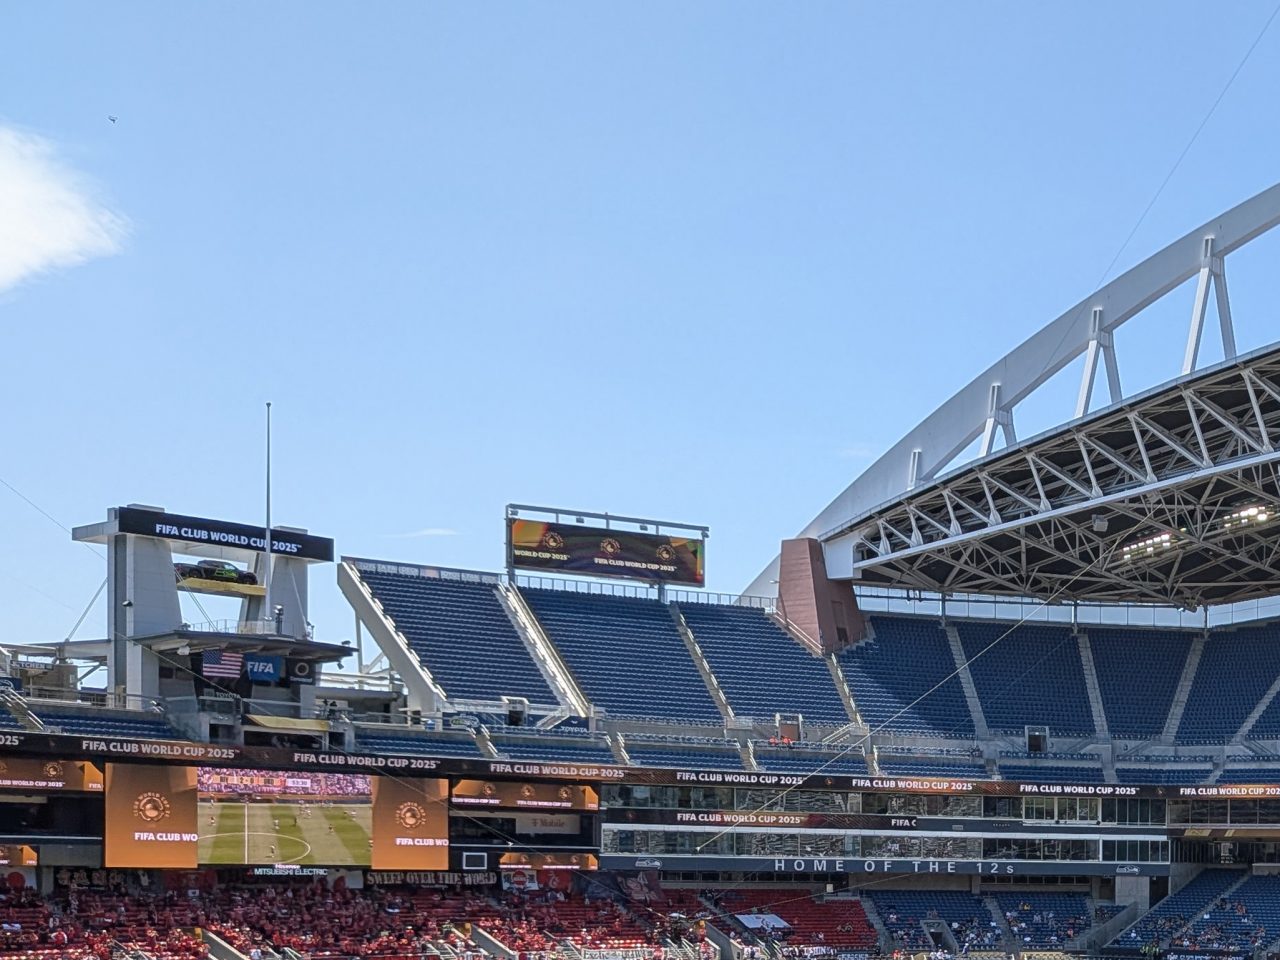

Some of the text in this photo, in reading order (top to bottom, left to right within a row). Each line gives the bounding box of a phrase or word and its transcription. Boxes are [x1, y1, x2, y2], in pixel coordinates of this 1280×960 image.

[156, 523, 179, 536] FIFA
[181, 527, 208, 540] CLUB
[210, 530, 248, 545] WORLD
[248, 661, 274, 674] FIFA
[82, 740, 205, 757] FIFA CLUB WORLD CUP
[294, 752, 409, 768] FIFA CLUB WORLD CUP
[852, 778, 949, 790] FIFA CLUB WORLD CUP
[1020, 784, 1113, 794] FIFA CLUB WORLD CUP
[1179, 787, 1197, 796] FIFA
[1218, 787, 1247, 795] WORLD
[1248, 787, 1264, 795] CUP
[891, 818, 910, 827] FIFA
[135, 832, 198, 841] FIFA CLUB WO
[775, 859, 1014, 874] HOME OF THE 12s
[367, 872, 404, 885] SWEEP
[406, 872, 436, 884] OVER
[463, 872, 497, 884] WORLD
